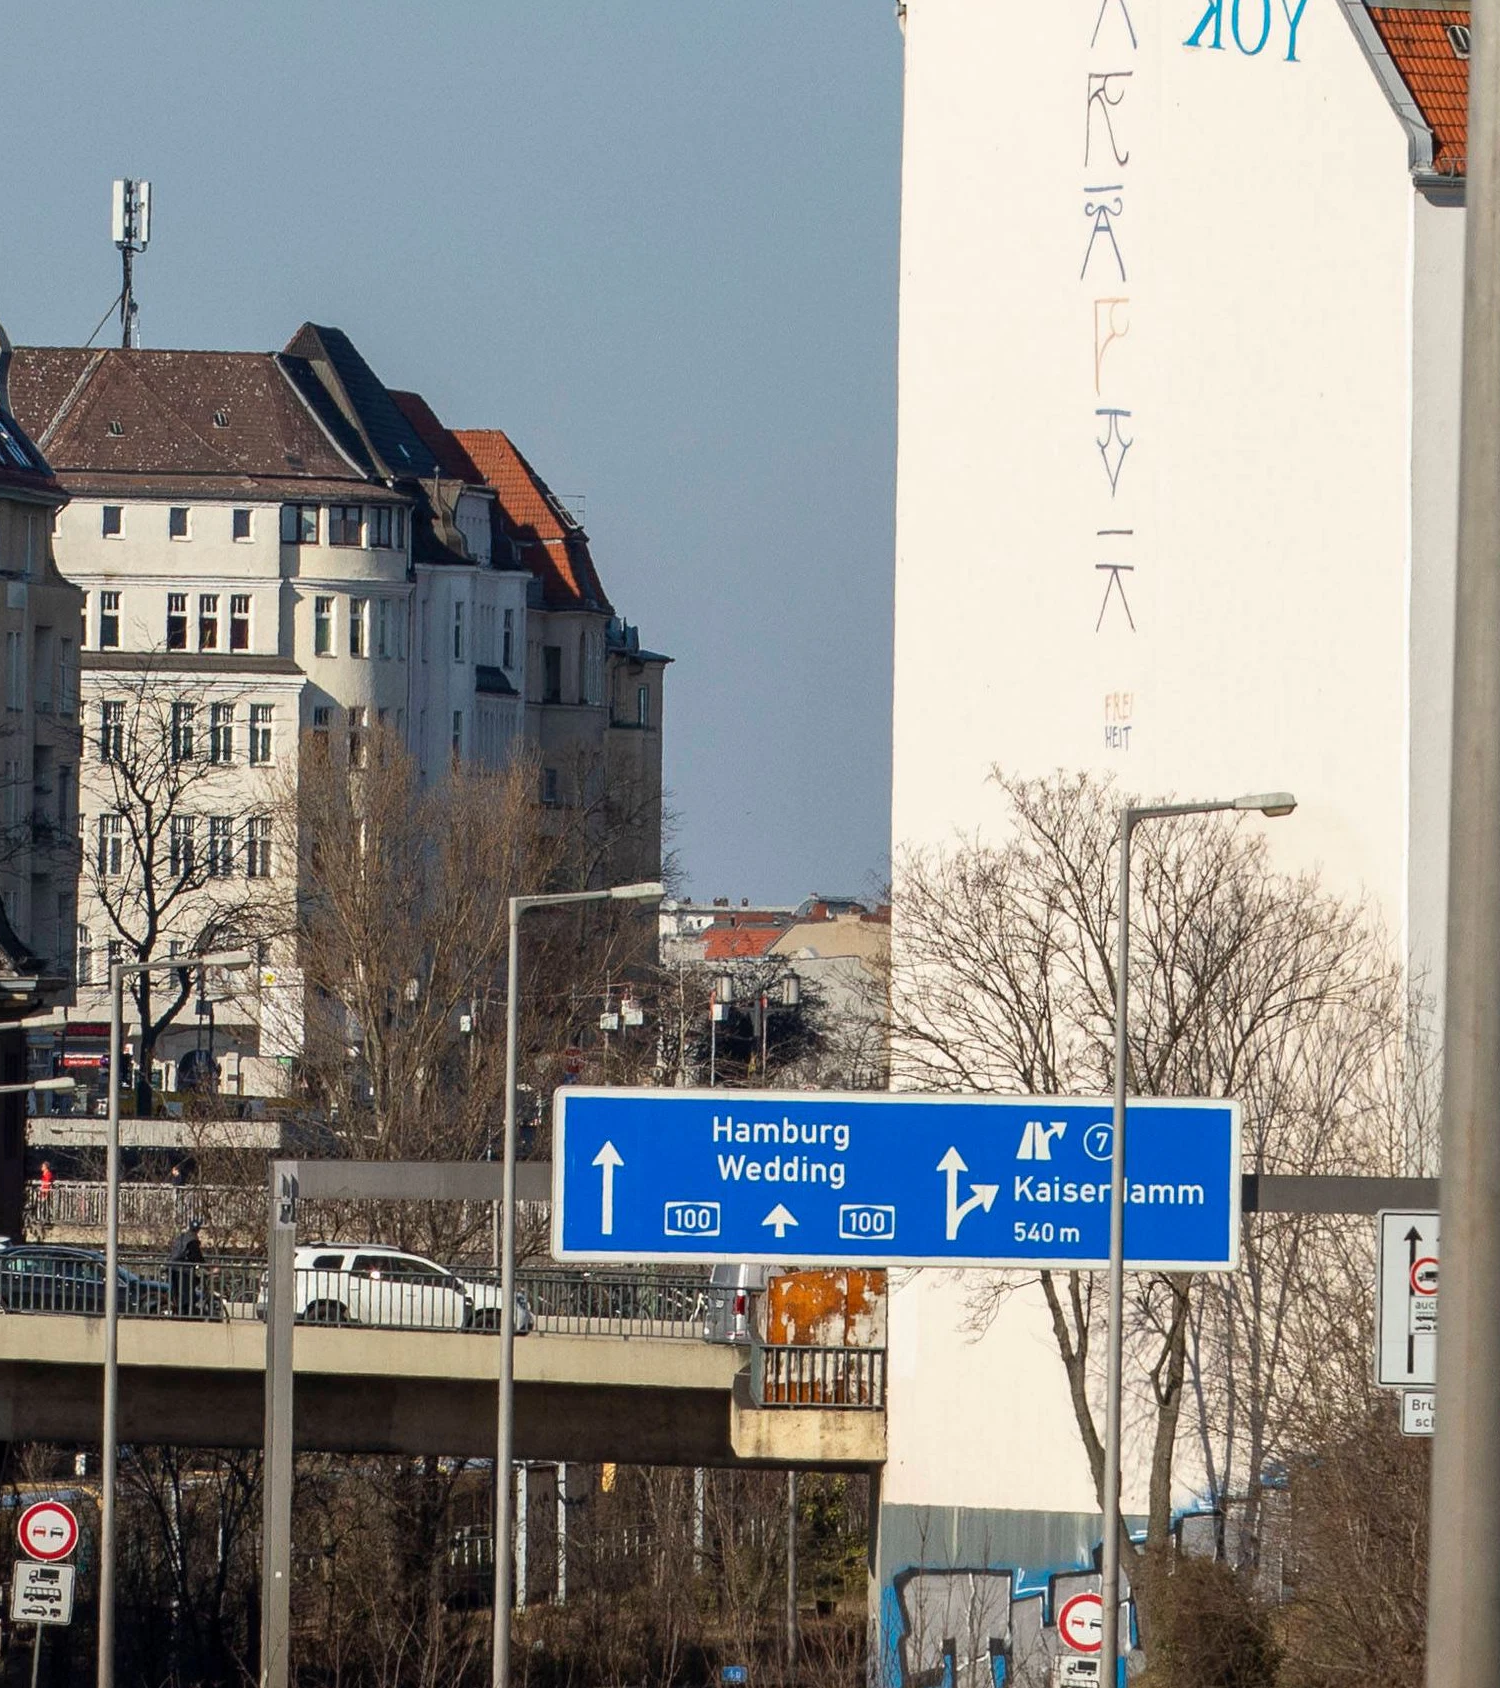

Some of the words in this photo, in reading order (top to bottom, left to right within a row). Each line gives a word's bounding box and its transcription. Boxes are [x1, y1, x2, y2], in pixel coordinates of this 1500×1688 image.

[1104, 692, 1134, 722] FREI
[1104, 725, 1132, 751] HEIT
[713, 1116, 850, 1151] Hamburg
[1096, 1132, 1108, 1151] 7
[717, 1154, 846, 1190] Wedding
[675, 1208, 710, 1229] 100
[850, 1212, 886, 1232] 100
[1014, 1222, 1054, 1242] 540
[1060, 1227, 1080, 1242] m
